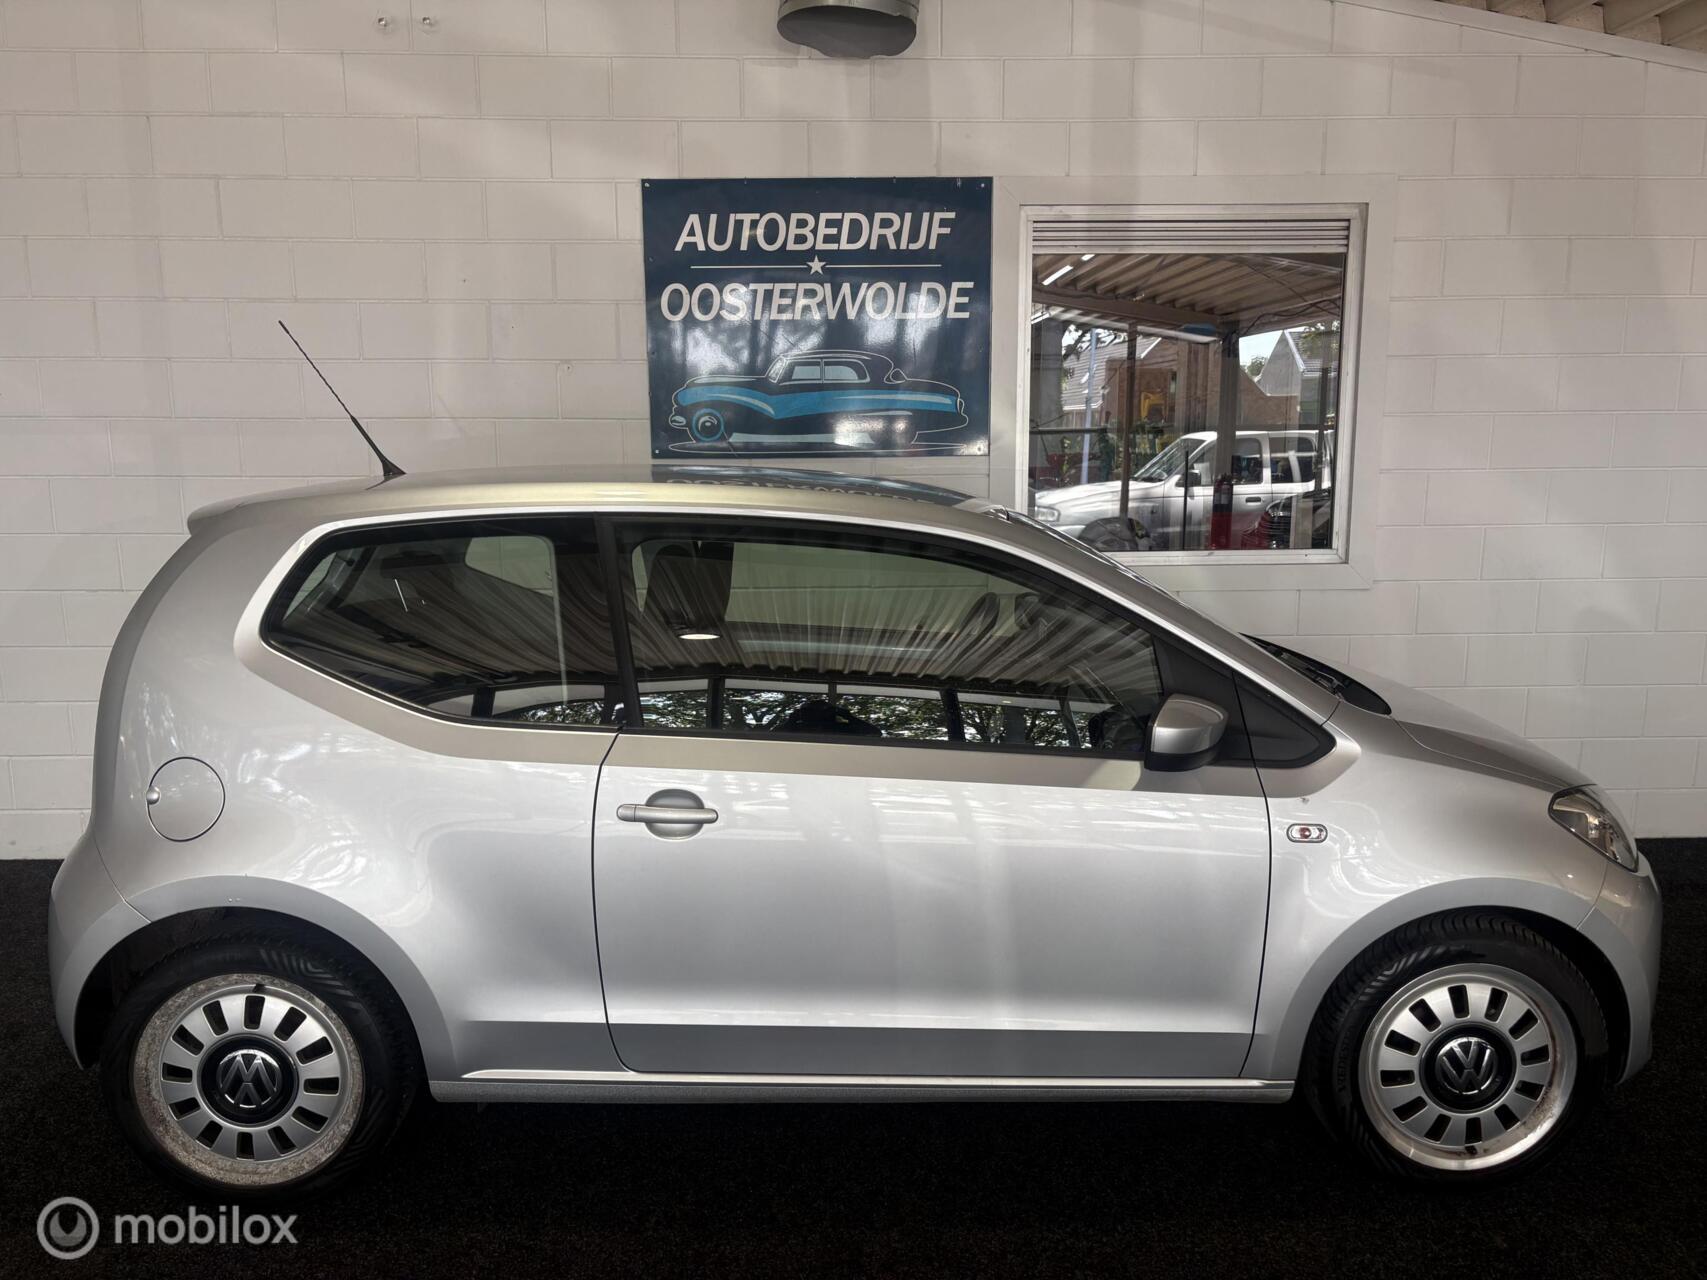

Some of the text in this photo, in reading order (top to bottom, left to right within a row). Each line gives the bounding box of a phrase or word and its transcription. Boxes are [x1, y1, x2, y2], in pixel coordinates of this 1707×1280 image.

[674, 211, 956, 252] AUTOBEDRIJF
[660, 281, 975, 322] OOSTERWOLDE
[1436, 1036, 1498, 1095] VW
